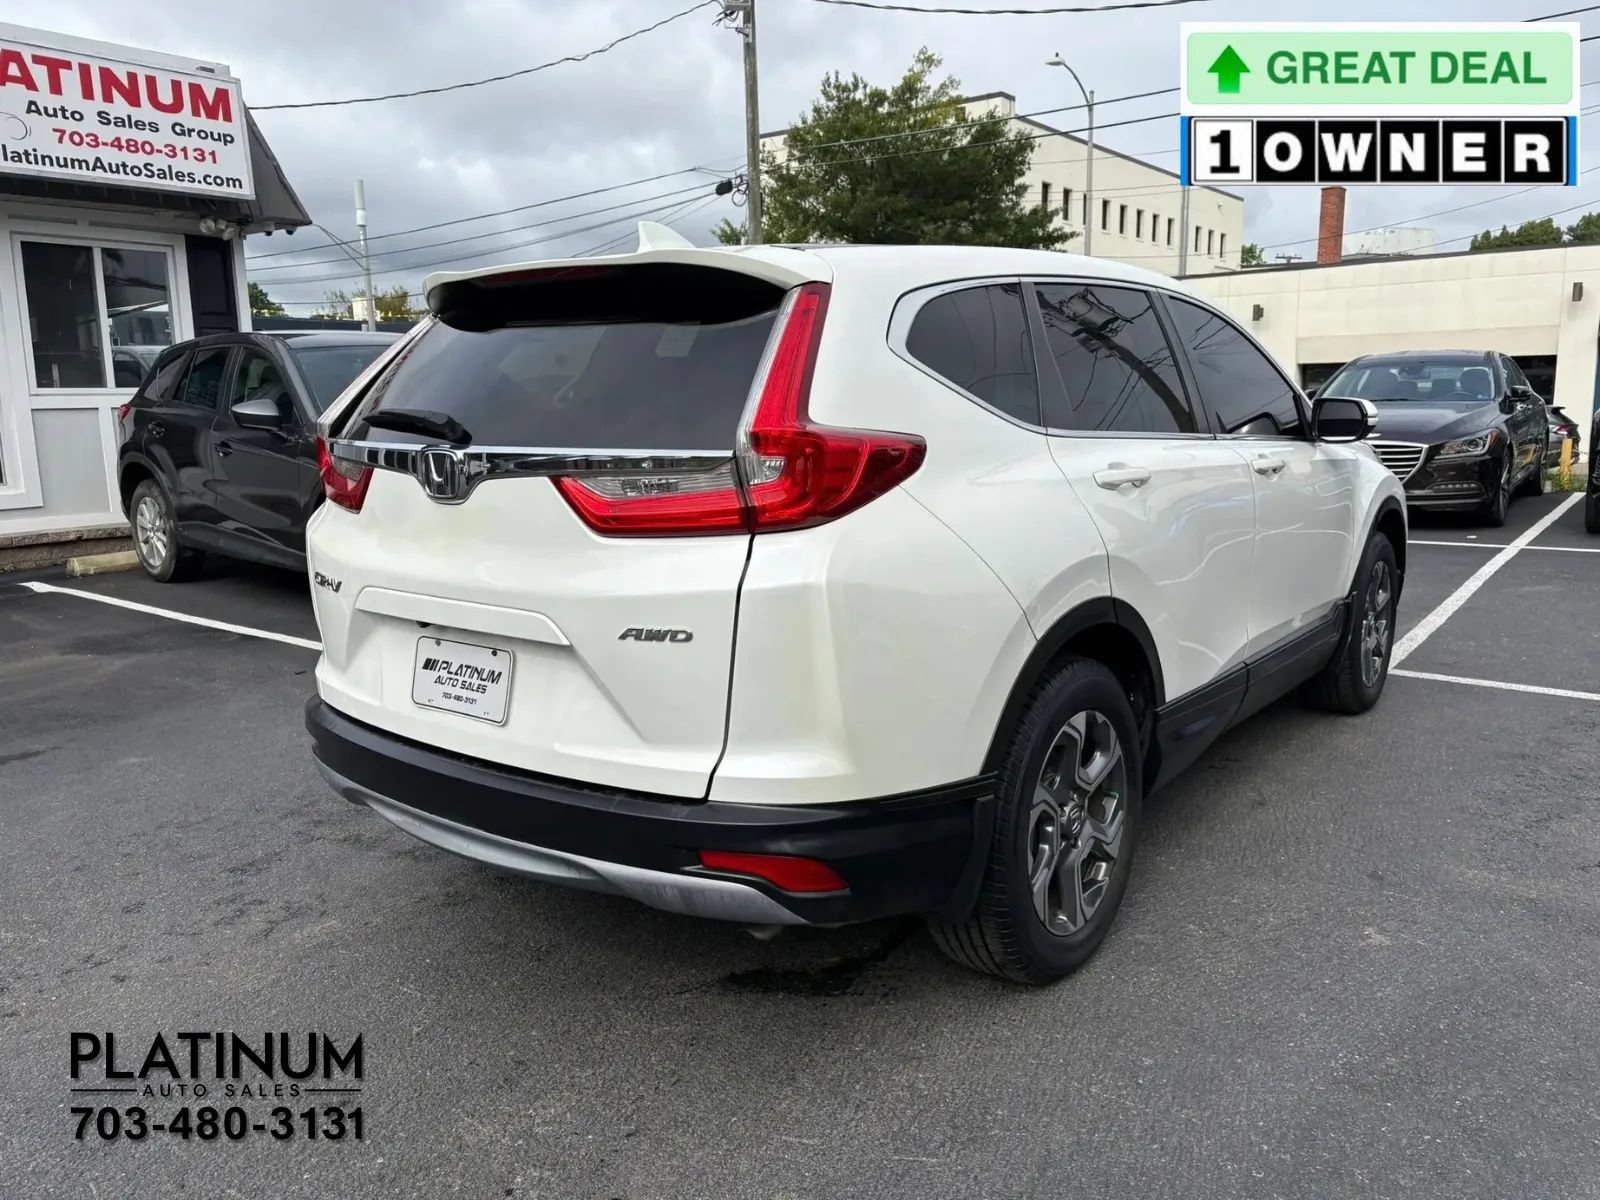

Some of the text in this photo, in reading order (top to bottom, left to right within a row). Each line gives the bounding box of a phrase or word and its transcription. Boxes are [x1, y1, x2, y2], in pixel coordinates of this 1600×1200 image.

[25, 100, 235, 146] Auto Sales Group
[52, 128, 218, 164] 703-480-3131
[618, 628, 693, 643] AWD
[438, 660, 502, 684] PLATINUM
[434, 675, 487, 694] AUTO SALES
[442, 692, 477, 704] 703-480-3131
